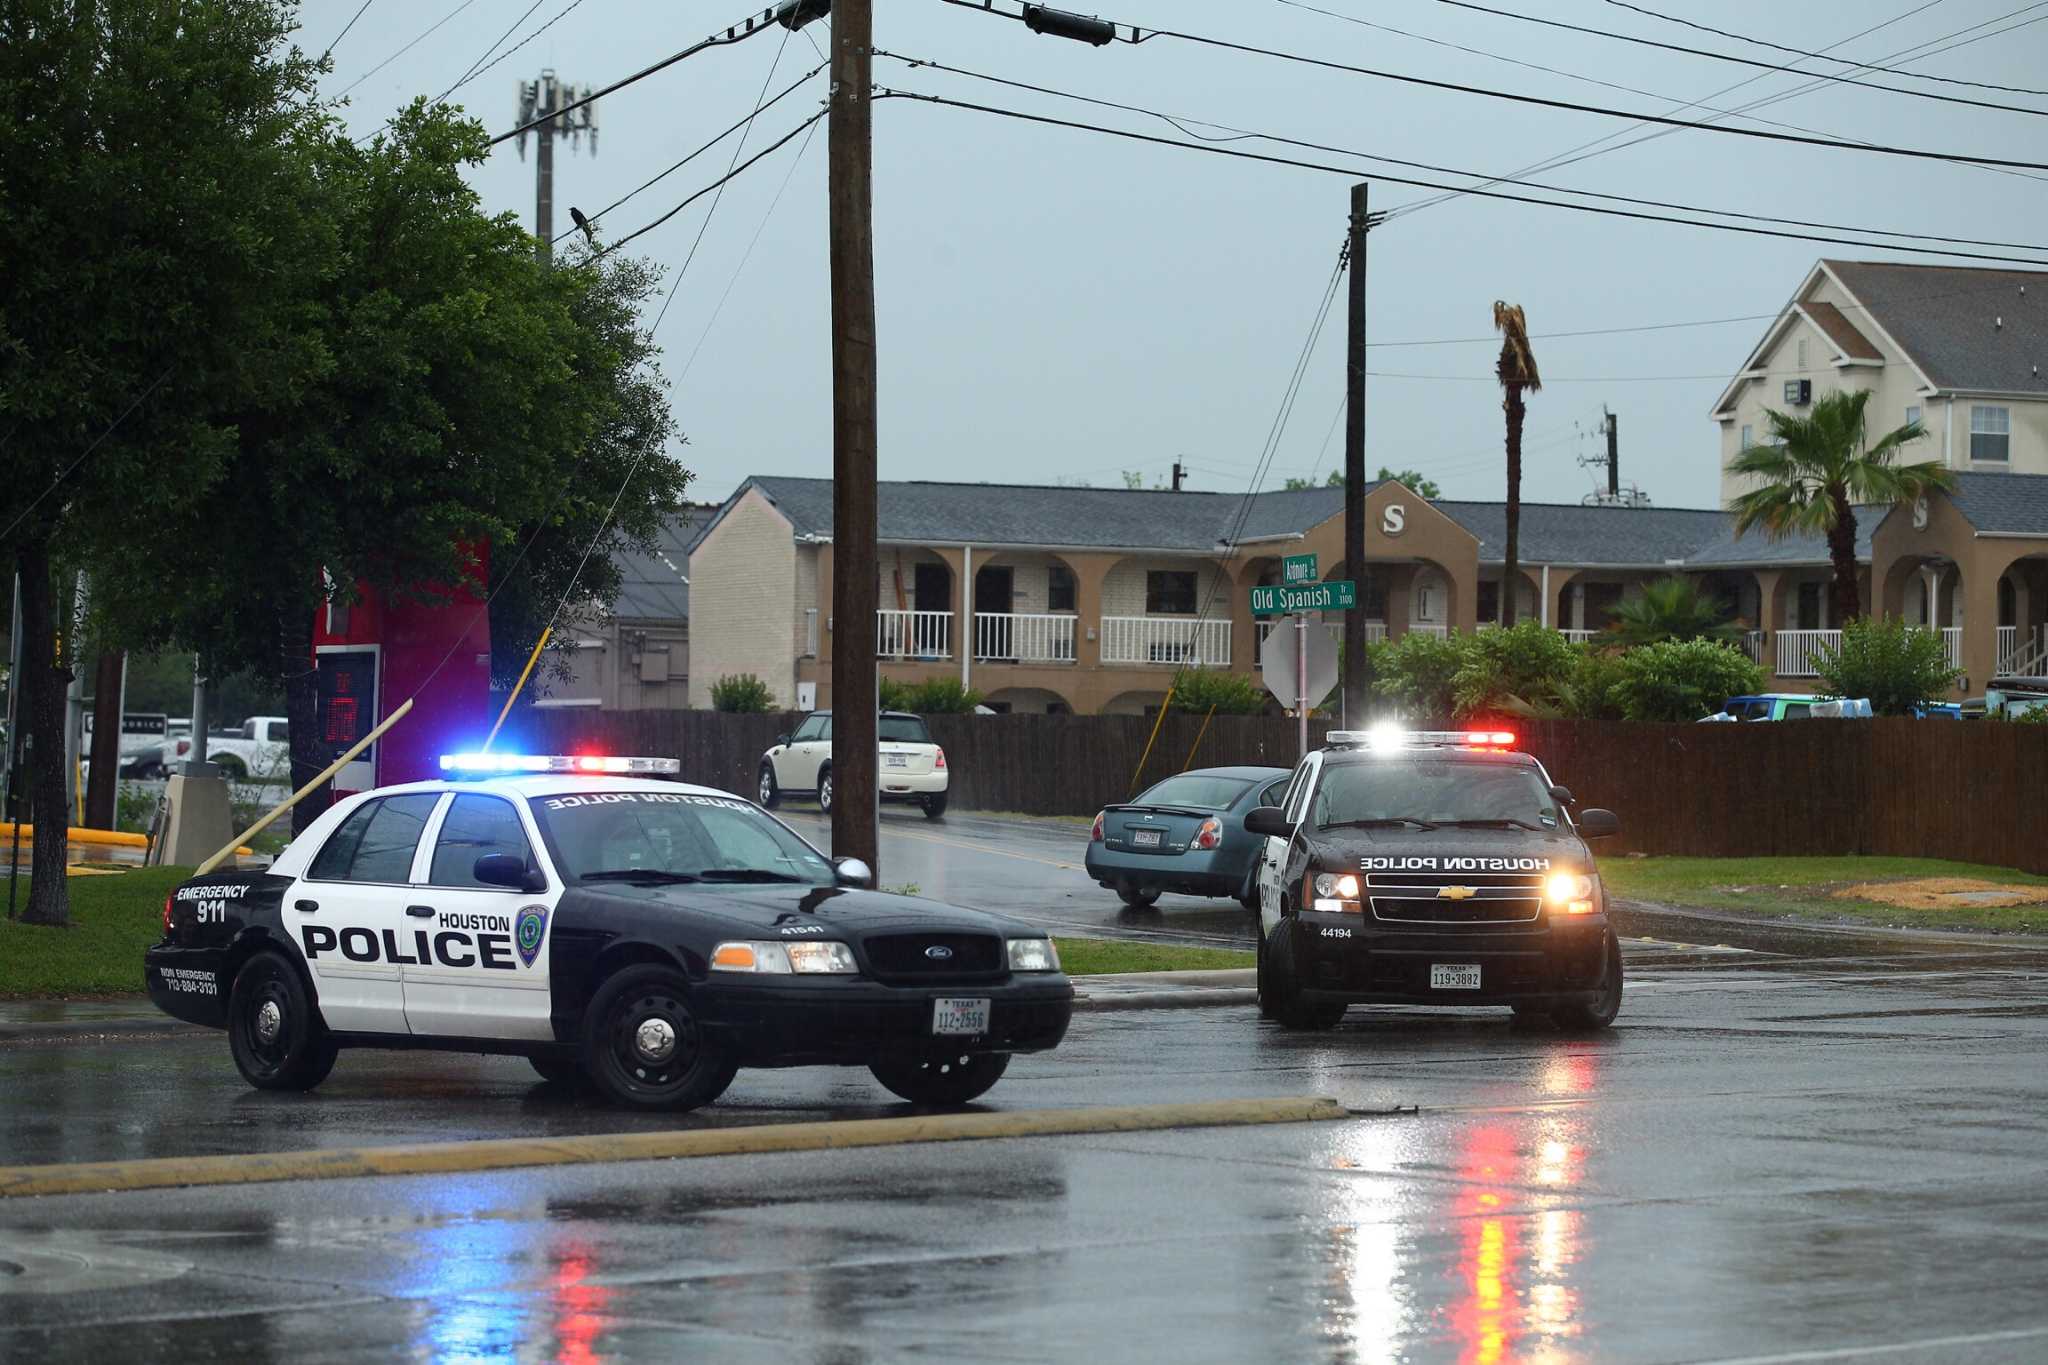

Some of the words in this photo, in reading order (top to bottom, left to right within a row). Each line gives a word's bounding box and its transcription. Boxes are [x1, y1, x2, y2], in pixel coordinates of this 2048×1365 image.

[1384, 504, 1405, 532] S
[1286, 560, 1308, 581] Ardmore
[1253, 589, 1274, 609] Old
[1279, 586, 1331, 611] Spanish
[177, 885, 250, 901] EMERGENCY
[197, 899, 226, 923] 911
[439, 912, 510, 932] HOUSTON
[1320, 928, 1352, 938] 44194
[301, 925, 517, 970] POLICE
[160, 967, 175, 978] NON
[175, 968, 216, 982] EMERGENCY
